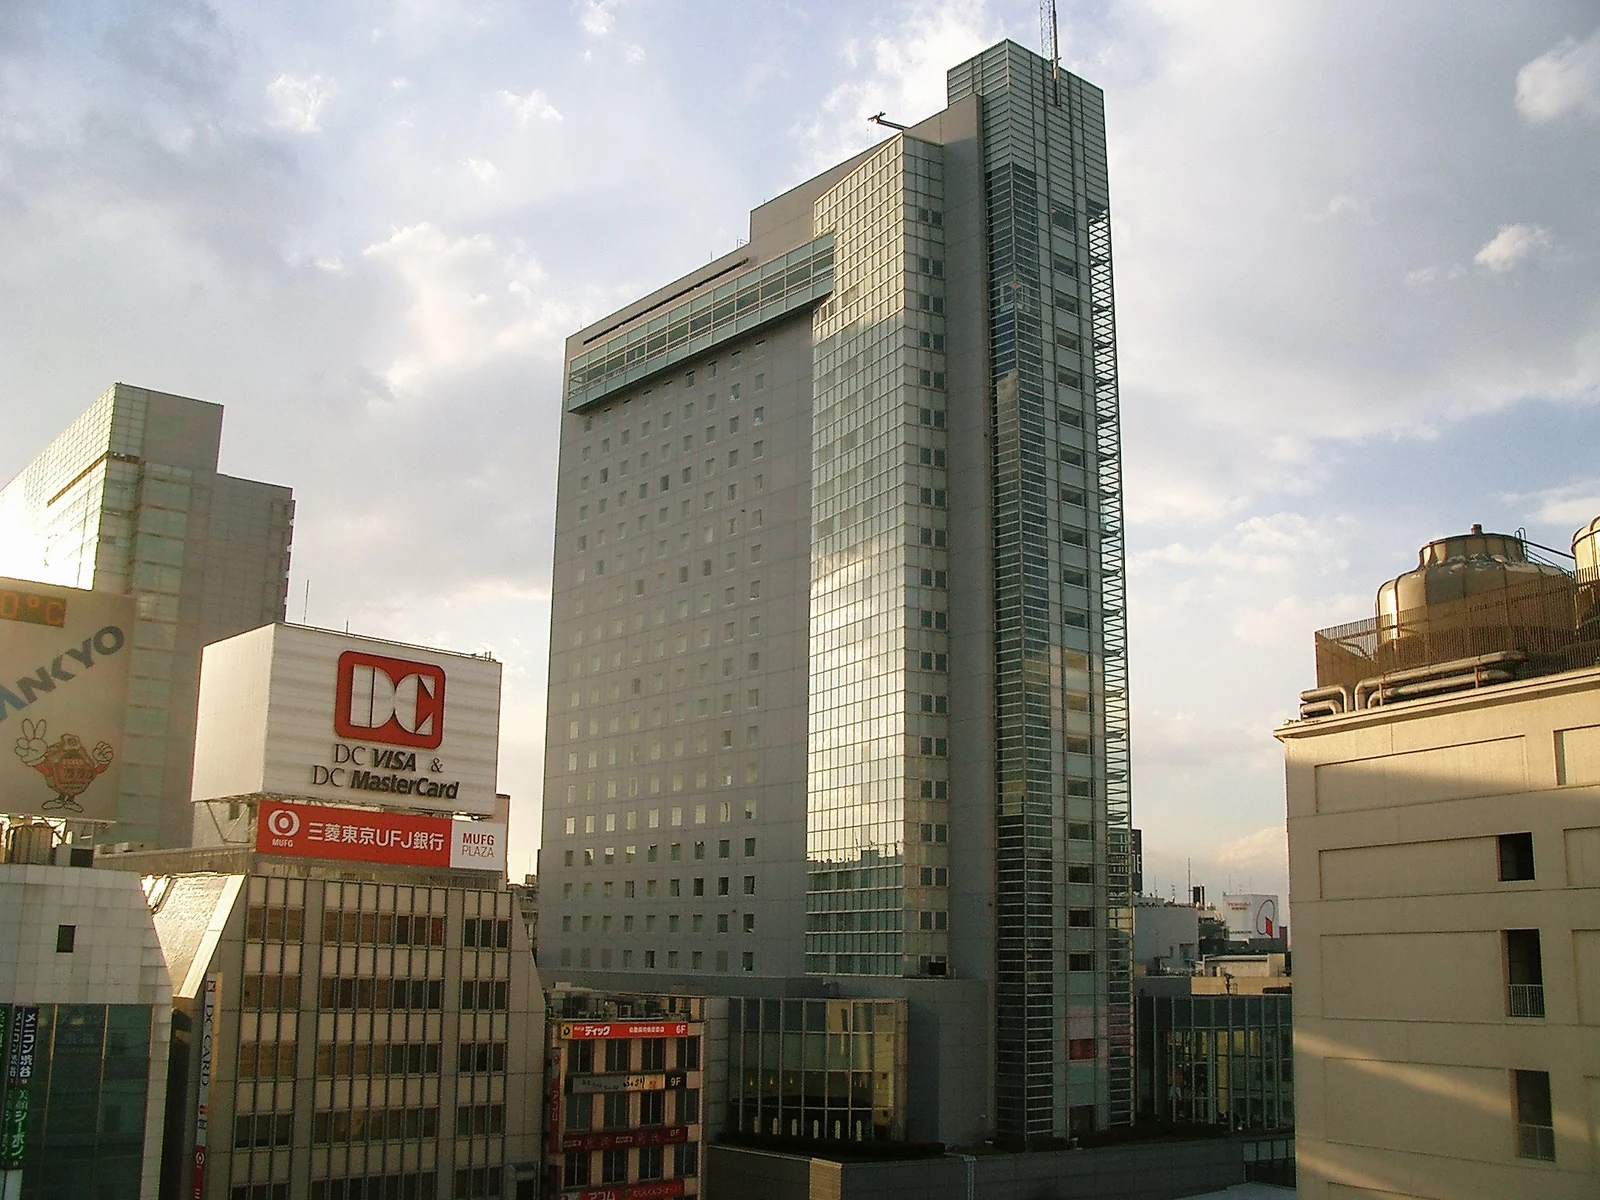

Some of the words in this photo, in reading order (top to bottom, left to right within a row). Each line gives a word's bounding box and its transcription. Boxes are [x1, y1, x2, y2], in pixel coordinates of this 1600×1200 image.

[348, 662, 436, 737] DC
[334, 743, 366, 766] DC
[372, 748, 417, 772] VISA
[430, 757, 444, 773] &
[312, 765, 345, 788] DC
[350, 769, 460, 799] MasterCard
[272, 838, 294, 848] MUFG
[307, 822, 444, 851] 三菱東京UFJ銀行
[461, 844, 495, 858] PLAZA
[462, 832, 495, 846] MUFG
[19, 1012, 36, 1078] メニコン渋谷
